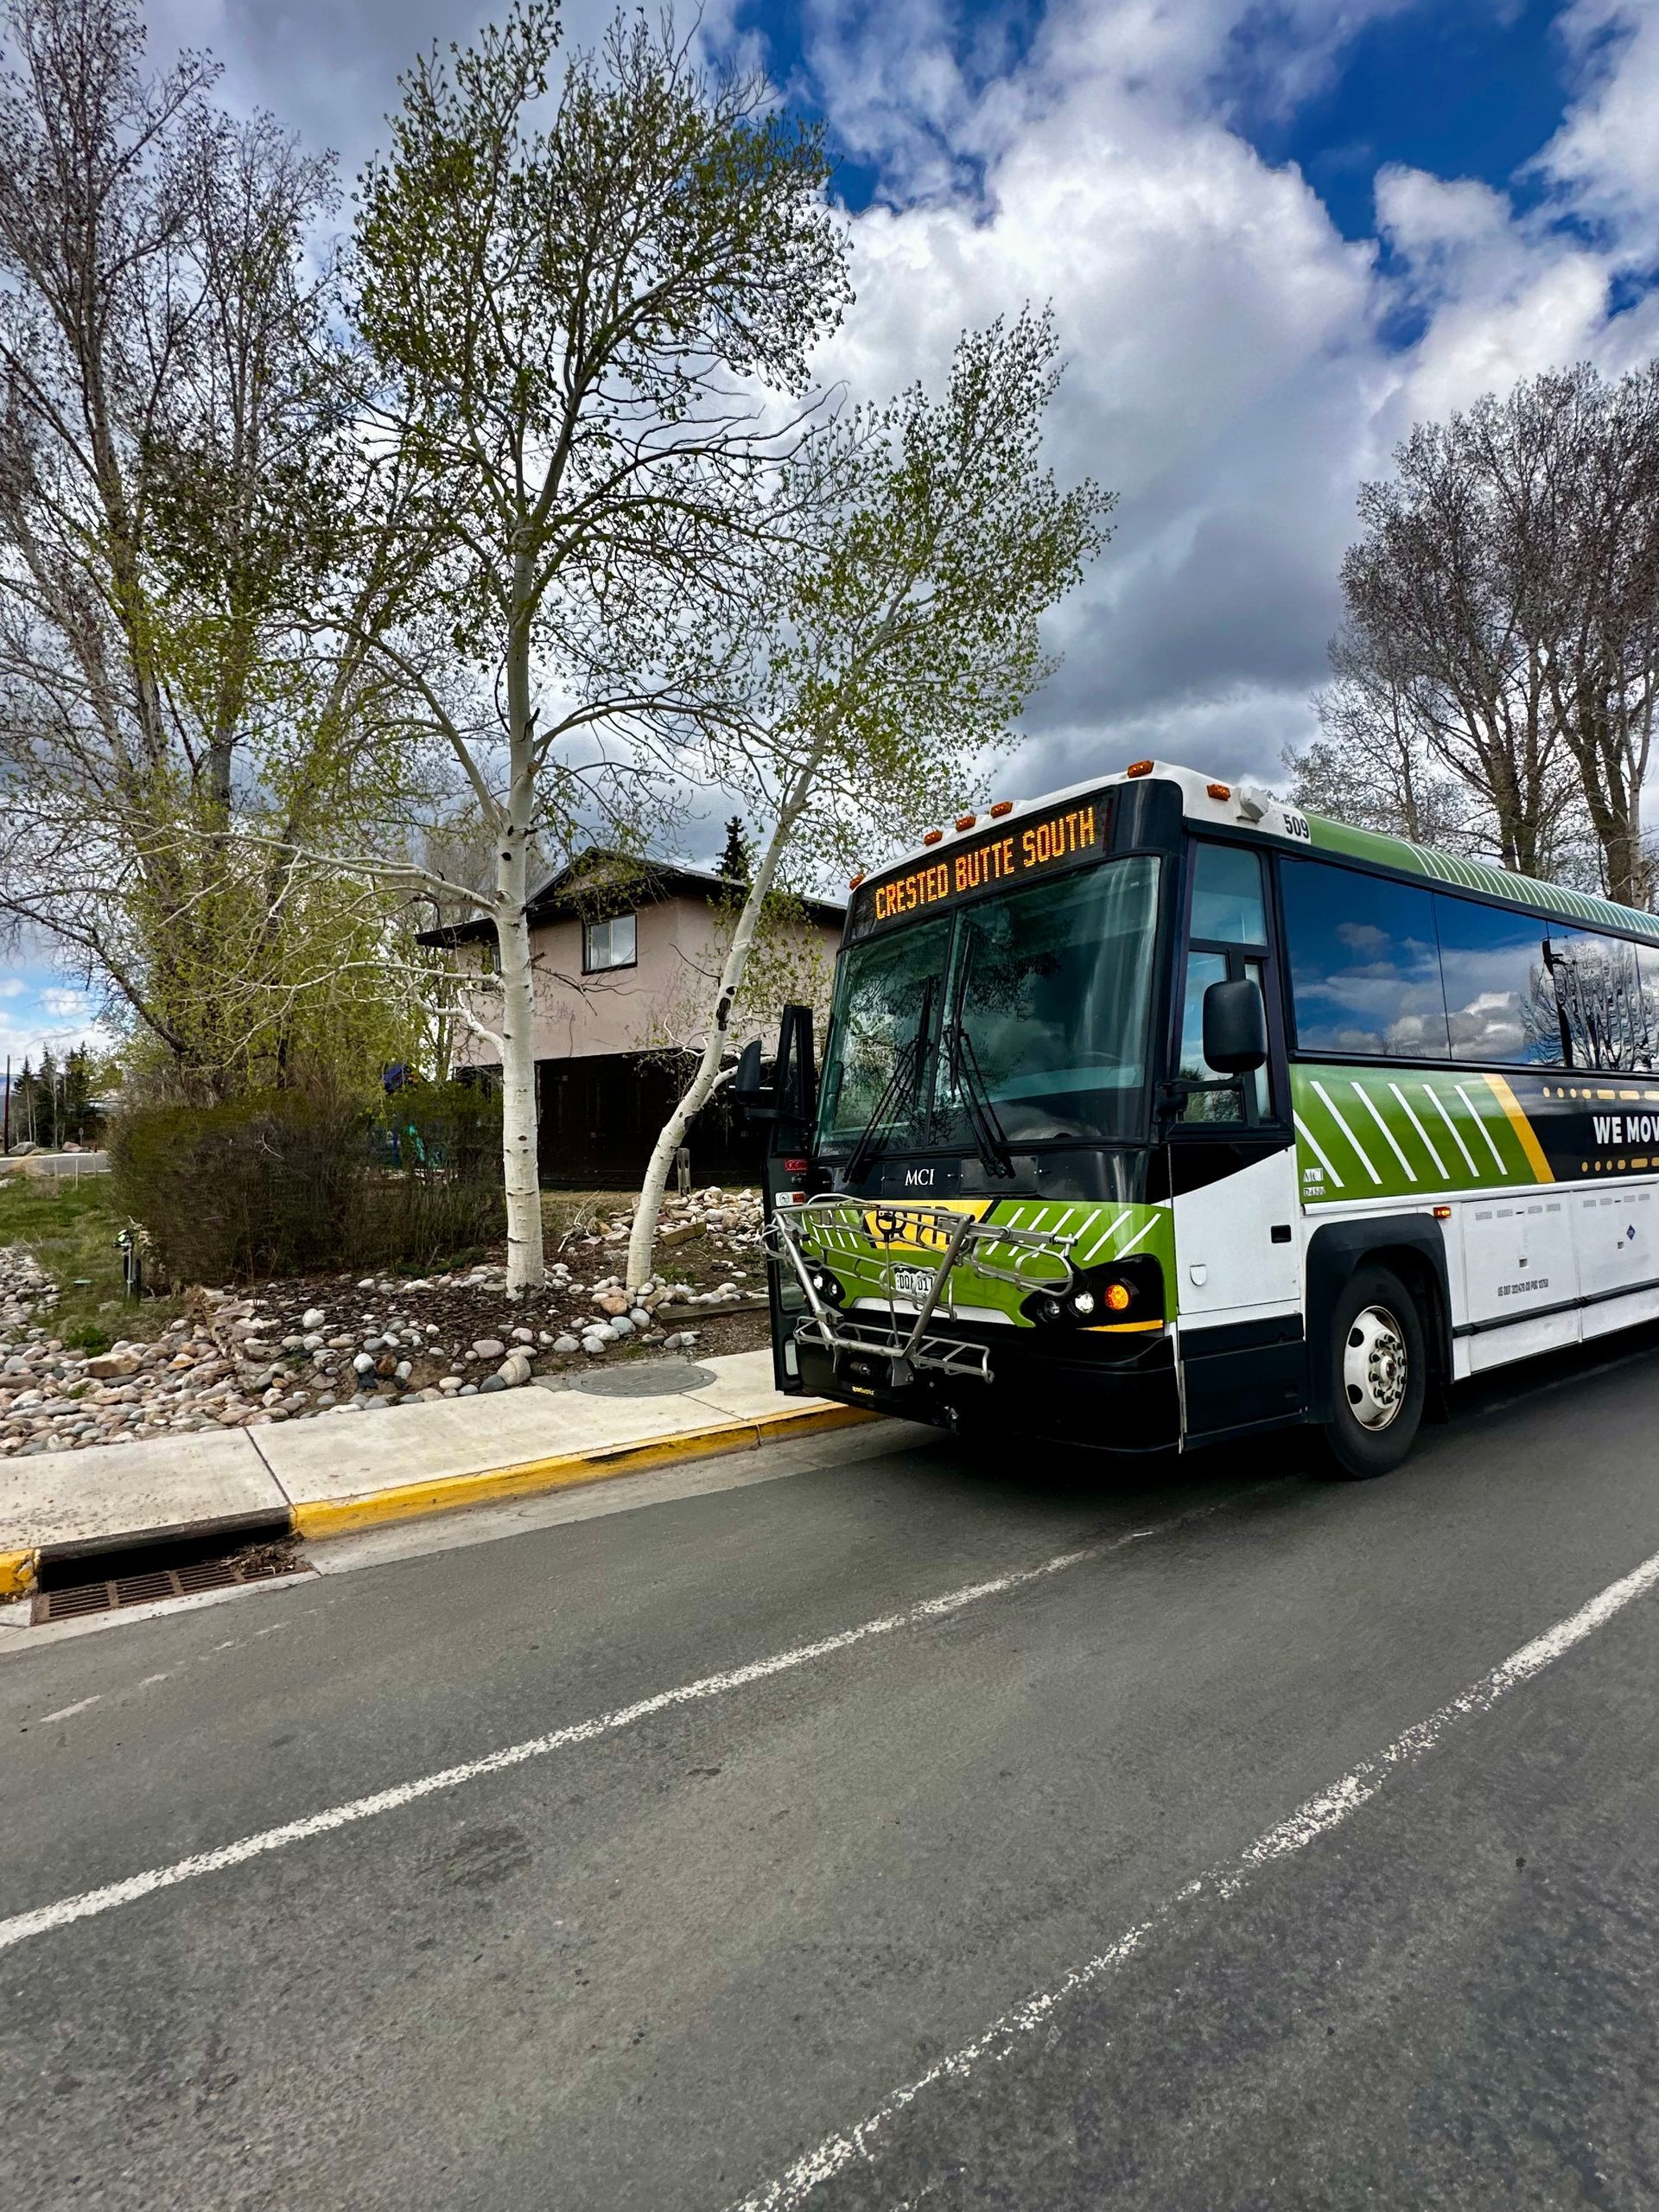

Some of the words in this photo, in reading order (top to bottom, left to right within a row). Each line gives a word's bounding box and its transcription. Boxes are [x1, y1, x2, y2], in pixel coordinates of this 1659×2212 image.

[1282, 813, 1310, 840] 509
[875, 864, 948, 919] CRESTED
[955, 836, 1014, 892] BUTTE
[1022, 806, 1096, 868] SOUTH
[1592, 1116, 1623, 1144] WE
[904, 1168, 935, 1187] MCI
[1304, 1168, 1324, 1183] MCI
